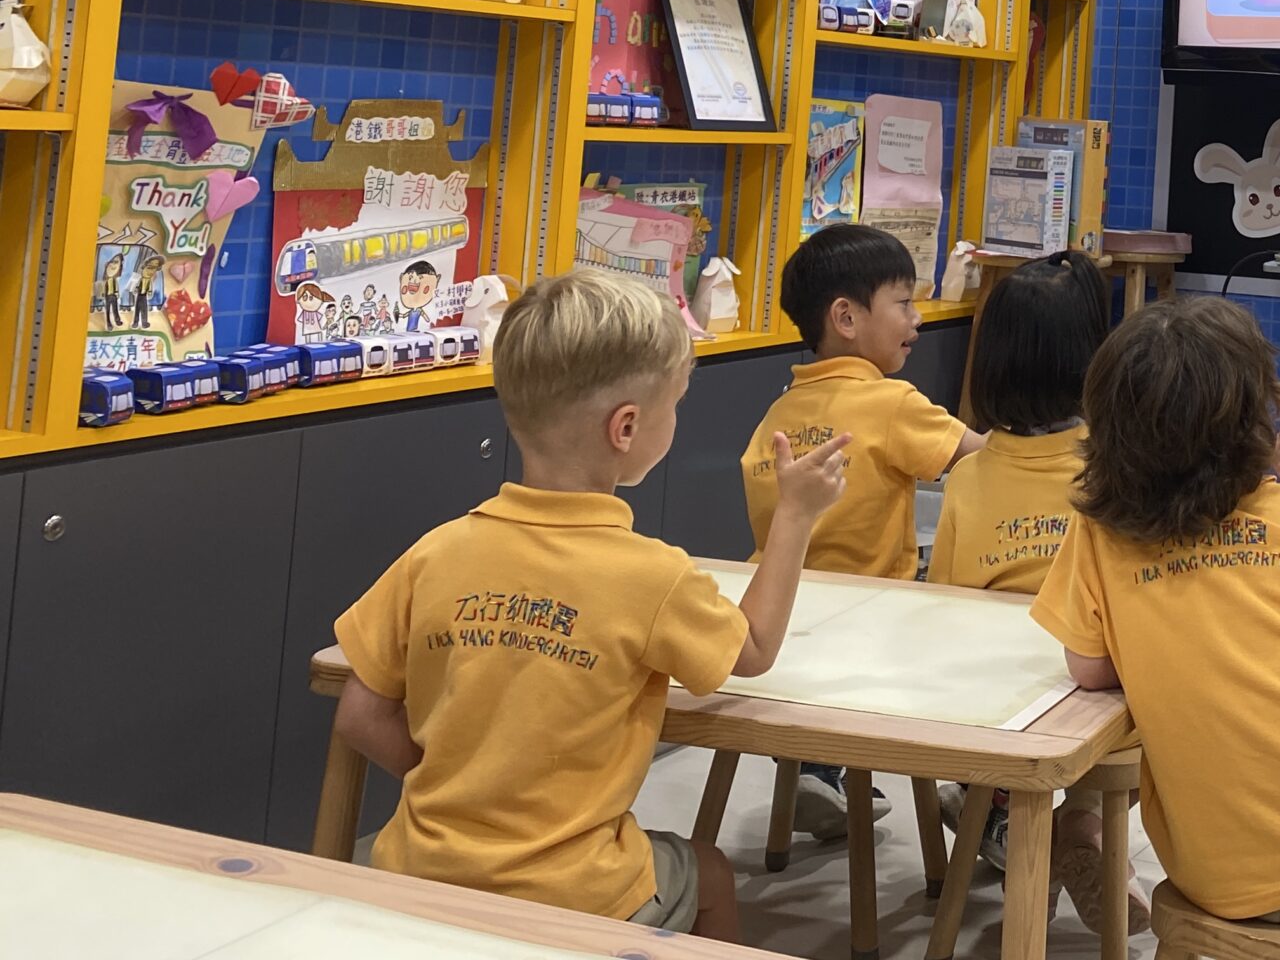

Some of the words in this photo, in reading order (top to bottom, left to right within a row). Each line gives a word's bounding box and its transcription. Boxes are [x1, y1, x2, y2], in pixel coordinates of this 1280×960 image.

[135, 181, 205, 209] Thank
[364, 169, 468, 212] 謝謝您
[170, 217, 209, 251] You!
[1167, 555, 1199, 576] HANG
[498, 630, 599, 671] KINDERGARTEN
